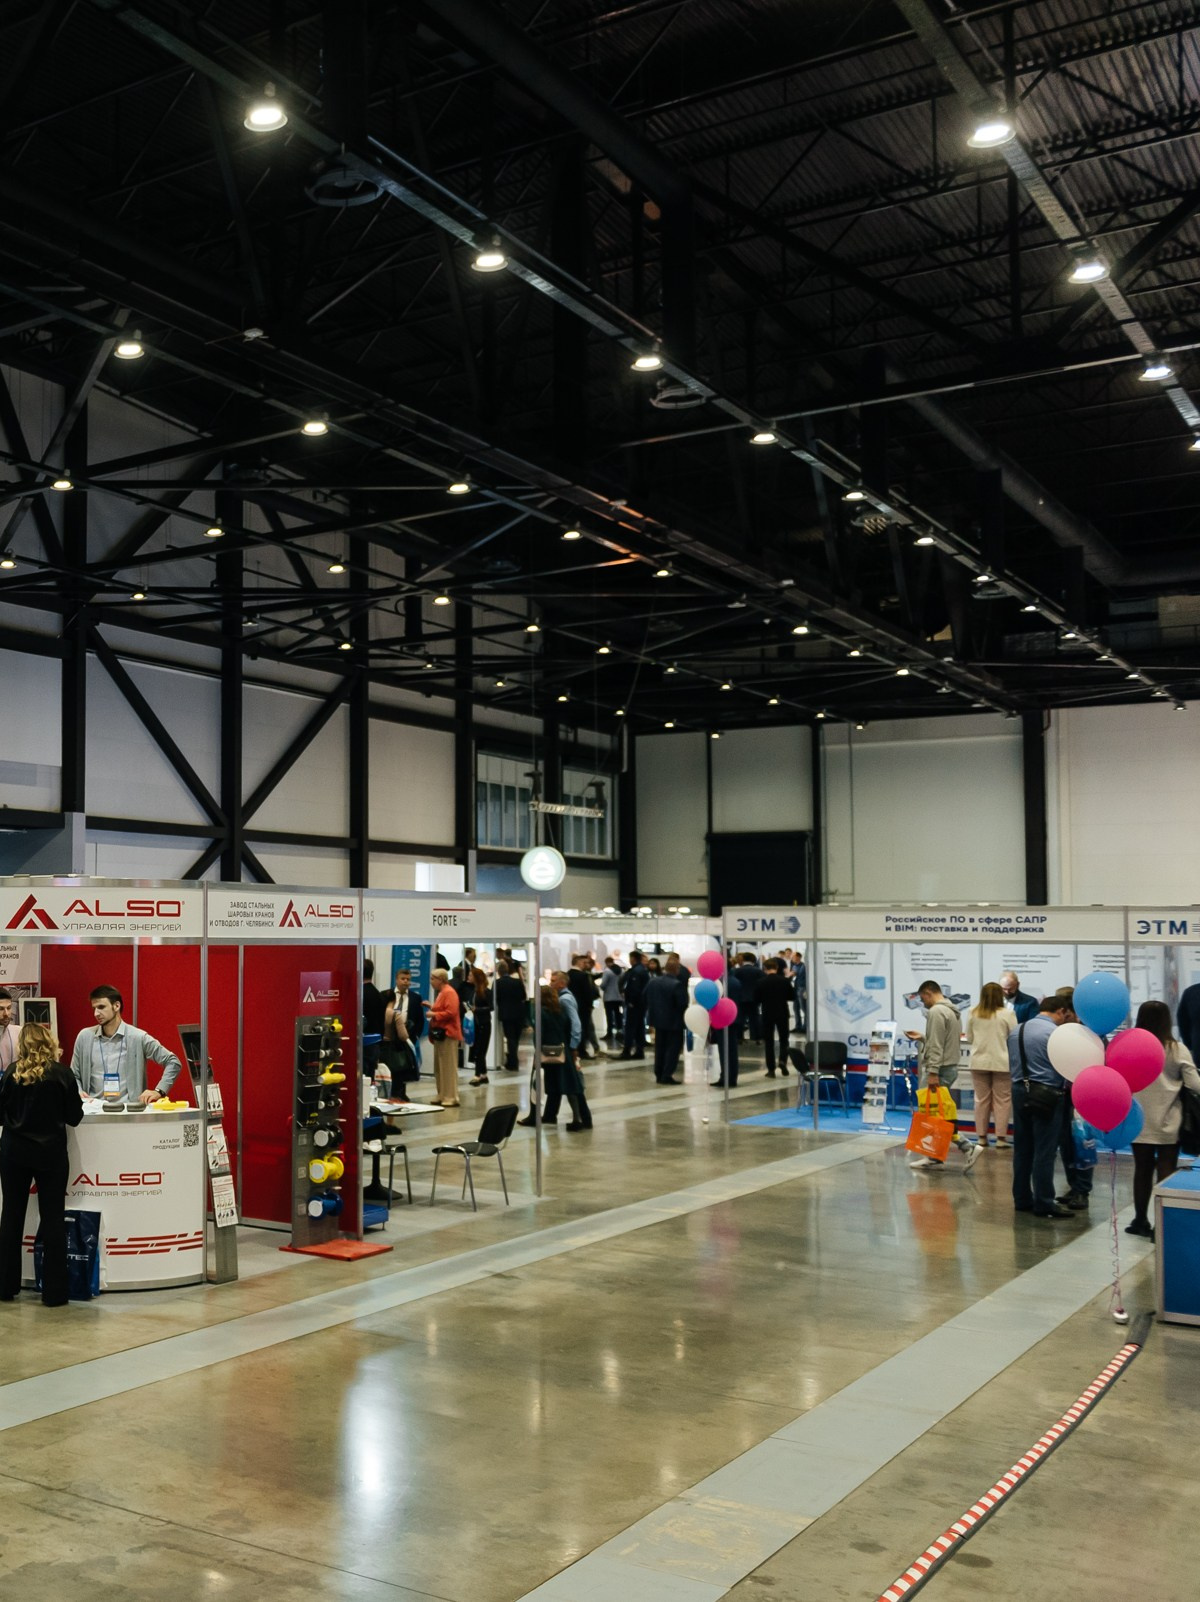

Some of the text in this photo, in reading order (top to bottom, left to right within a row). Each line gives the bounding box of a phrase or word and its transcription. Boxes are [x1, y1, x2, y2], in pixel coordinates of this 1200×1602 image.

[62, 899, 181, 917] ALSO
[229, 901, 247, 909] ЗАВОД
[254, 911, 275, 919] КРАНОВ
[304, 903, 354, 918] ALSO
[245, 920, 275, 928] ЧЕЛЯБИНСК
[432, 914, 458, 927] FORTE
[736, 918, 776, 932] ЭТМ
[885, 915, 947, 924] Российское
[949, 915, 967, 924] ПО
[977, 915, 1013, 926] сфере
[1014, 915, 1048, 924] САПР
[129, 922, 183, 931] ЭНЕРГИЕЙ
[980, 925, 1045, 935] поддержка
[1136, 919, 1188, 936] ЭТМ
[316, 989, 340, 997] ALSO
[72, 1172, 162, 1187] ALSO
[121, 1189, 163, 1197] ЭНЕРГИЕЙ
